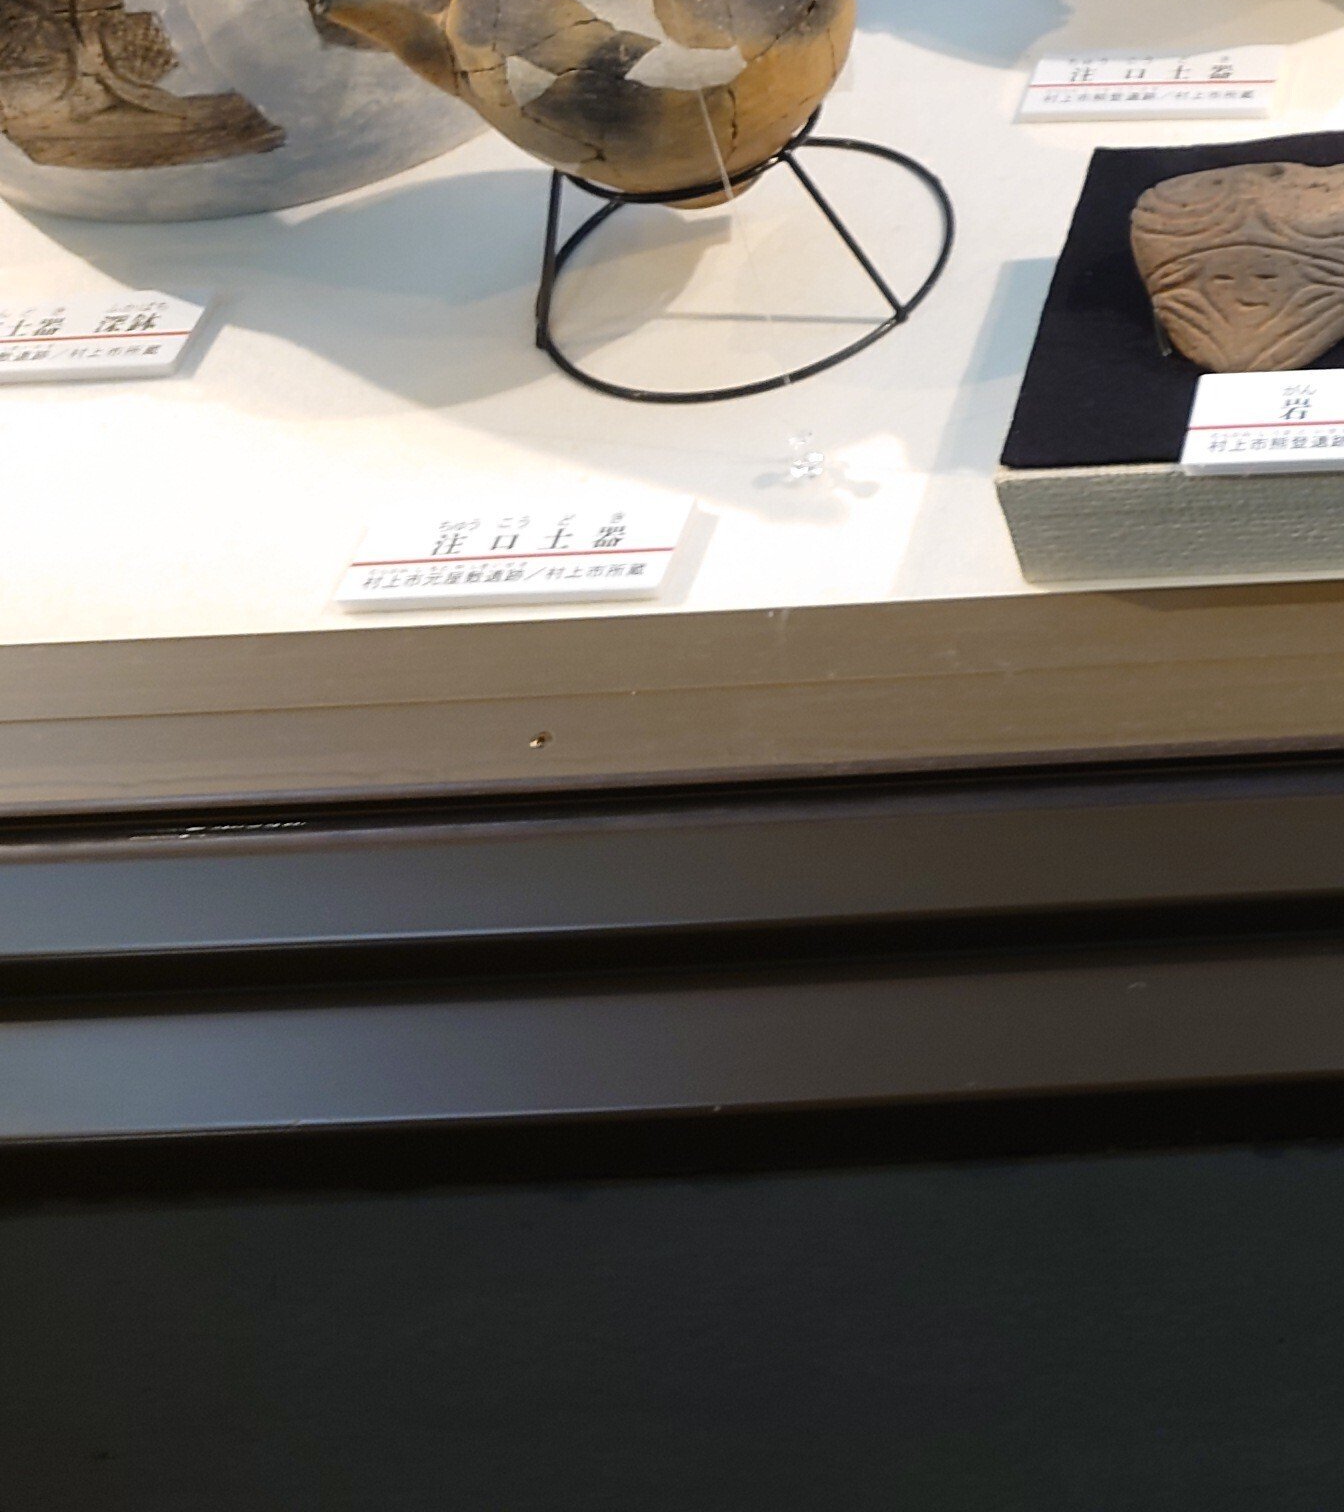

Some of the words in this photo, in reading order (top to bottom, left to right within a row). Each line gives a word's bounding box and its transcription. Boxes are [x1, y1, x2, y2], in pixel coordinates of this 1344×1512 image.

[0, 317, 66, 337] 土器
[430, 526, 627, 557] 注口土器
